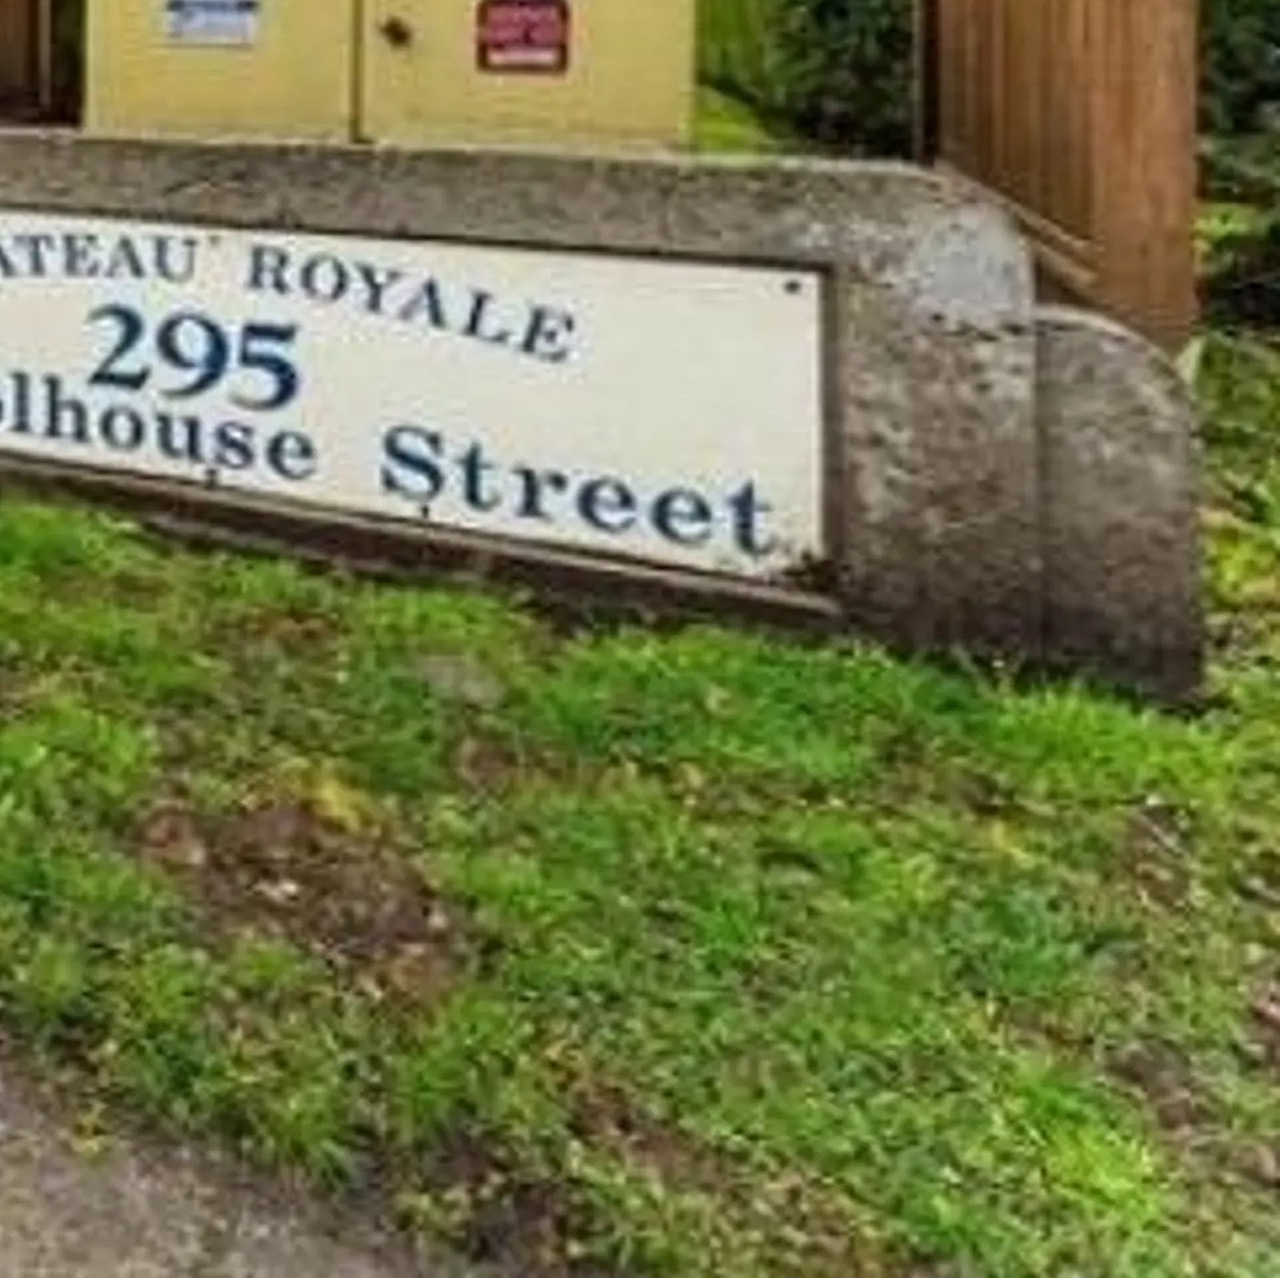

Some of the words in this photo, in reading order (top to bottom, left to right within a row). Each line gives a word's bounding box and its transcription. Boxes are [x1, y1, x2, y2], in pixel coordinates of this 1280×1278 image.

[86, 302, 300, 412] 295
[246, 243, 578, 364] ROYALE
[379, 424, 777, 558] Street
